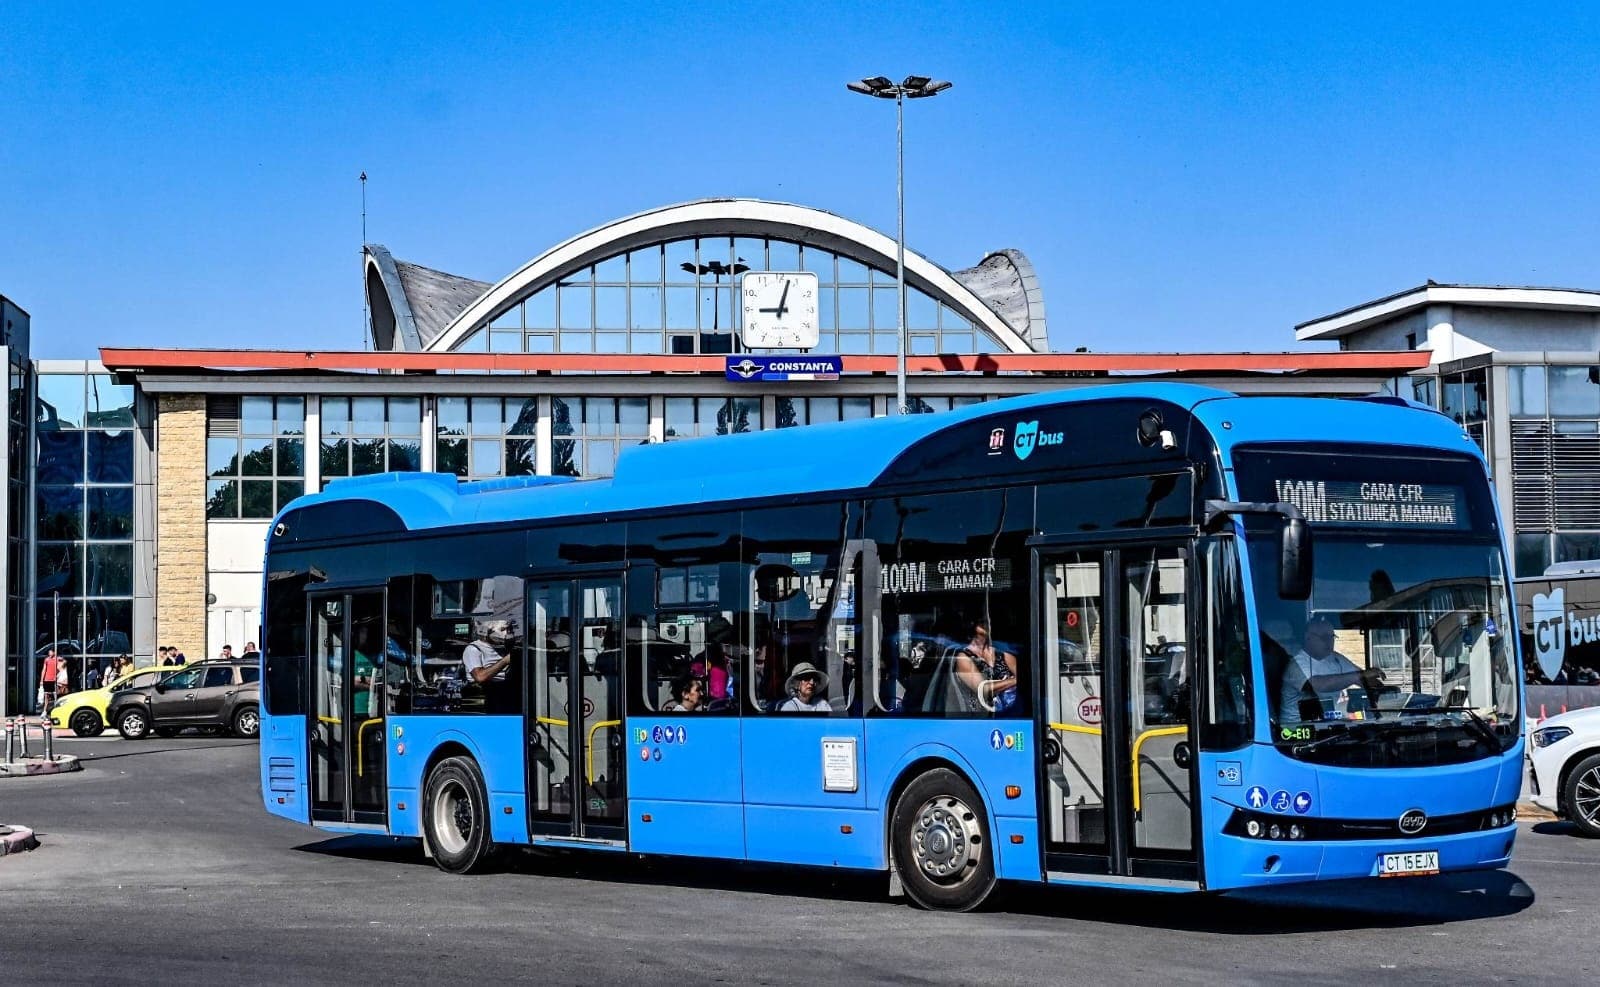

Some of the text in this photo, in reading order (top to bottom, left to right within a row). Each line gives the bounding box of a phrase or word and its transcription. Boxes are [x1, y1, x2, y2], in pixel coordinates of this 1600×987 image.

[775, 273, 785, 281] 12
[745, 289, 755, 297] 10
[1016, 430, 1064, 447] CT bus
[1360, 482, 1423, 502] GARA CFR
[1401, 504, 1454, 523] MAMAIA
[937, 558, 996, 574] GARA CFR
[881, 561, 926, 594] 100M
[943, 573, 994, 589] MAMAIA
[1537, 616, 1562, 653] CT
[1296, 728, 1311, 739] E13
[1387, 853, 1436, 871] CT 15 EJX
